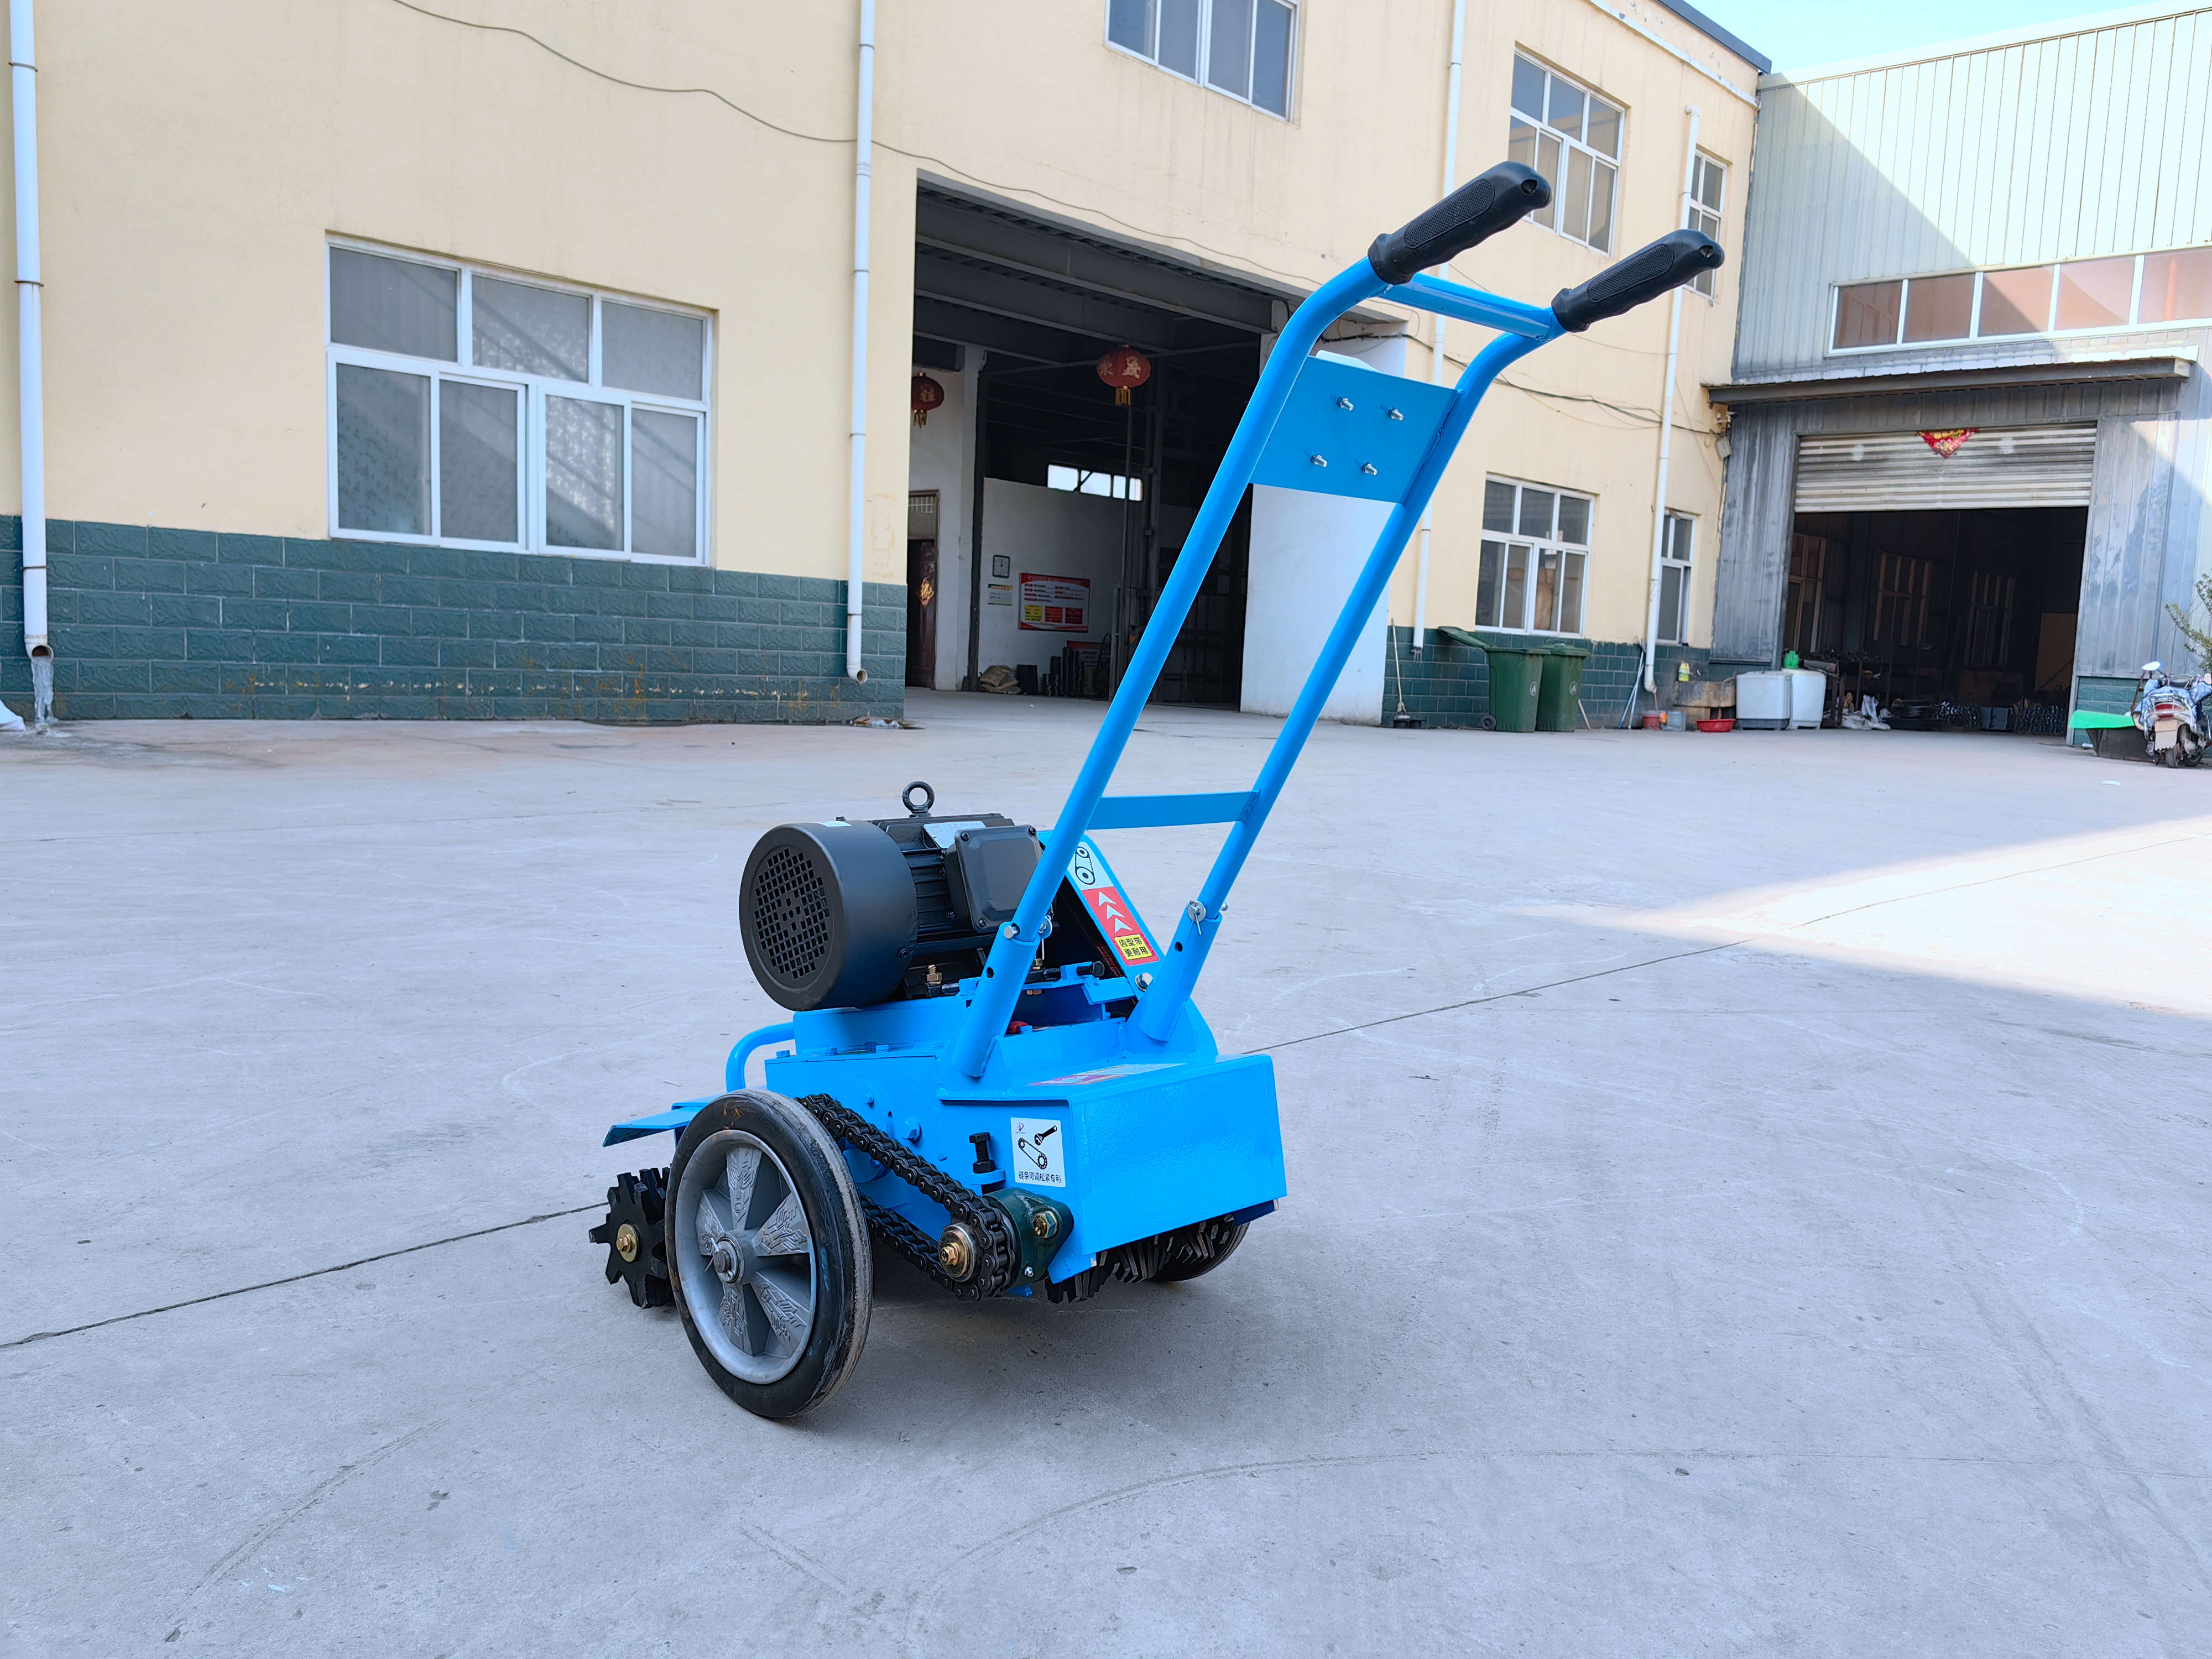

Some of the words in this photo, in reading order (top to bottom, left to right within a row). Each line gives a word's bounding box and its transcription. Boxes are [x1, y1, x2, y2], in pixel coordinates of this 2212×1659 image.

[1119, 937, 1142, 947] 齿型带
[1124, 947, 1148, 957] 更耐用
[1018, 1171, 1061, 1183] 链条可调松紧专利
